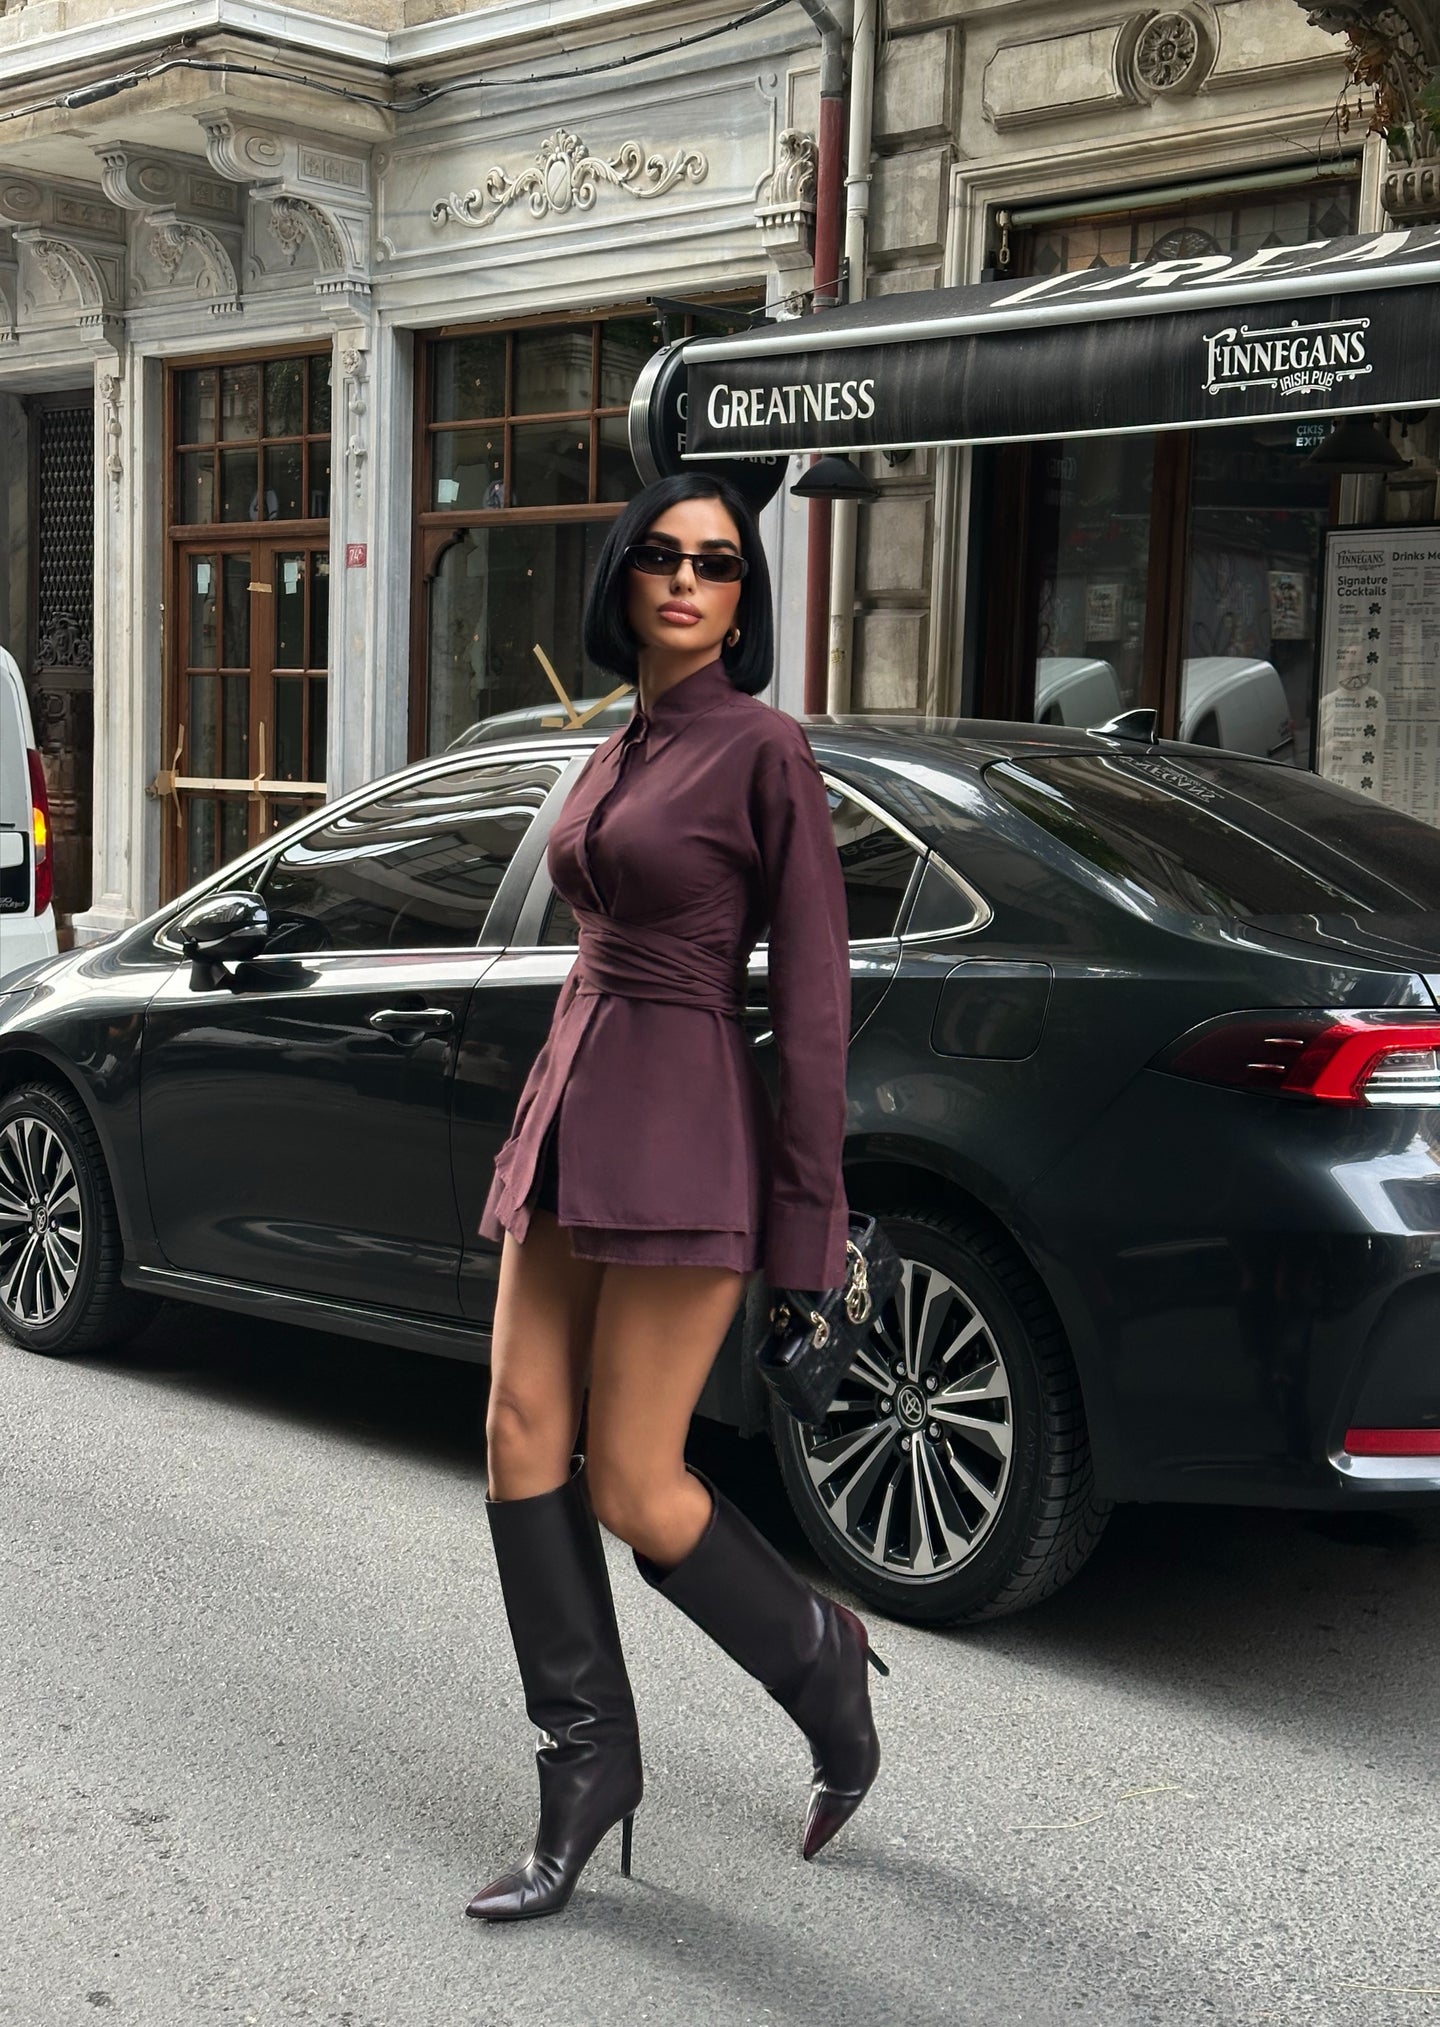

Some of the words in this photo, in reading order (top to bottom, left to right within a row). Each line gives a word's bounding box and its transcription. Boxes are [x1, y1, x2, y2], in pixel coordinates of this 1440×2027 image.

[1201, 327, 1366, 390] FINNEGANS
[1279, 371, 1309, 391] IRISH
[1311, 370, 1335, 387] PUB
[707, 378, 875, 429] GREATNESS
[1295, 436, 1326, 447] EXIT
[1336, 550, 1384, 569] FINNEGANS
[1392, 551, 1425, 561] Drinks
[1337, 575, 1388, 588] Signature
[1337, 586, 1387, 597] Cocktails
